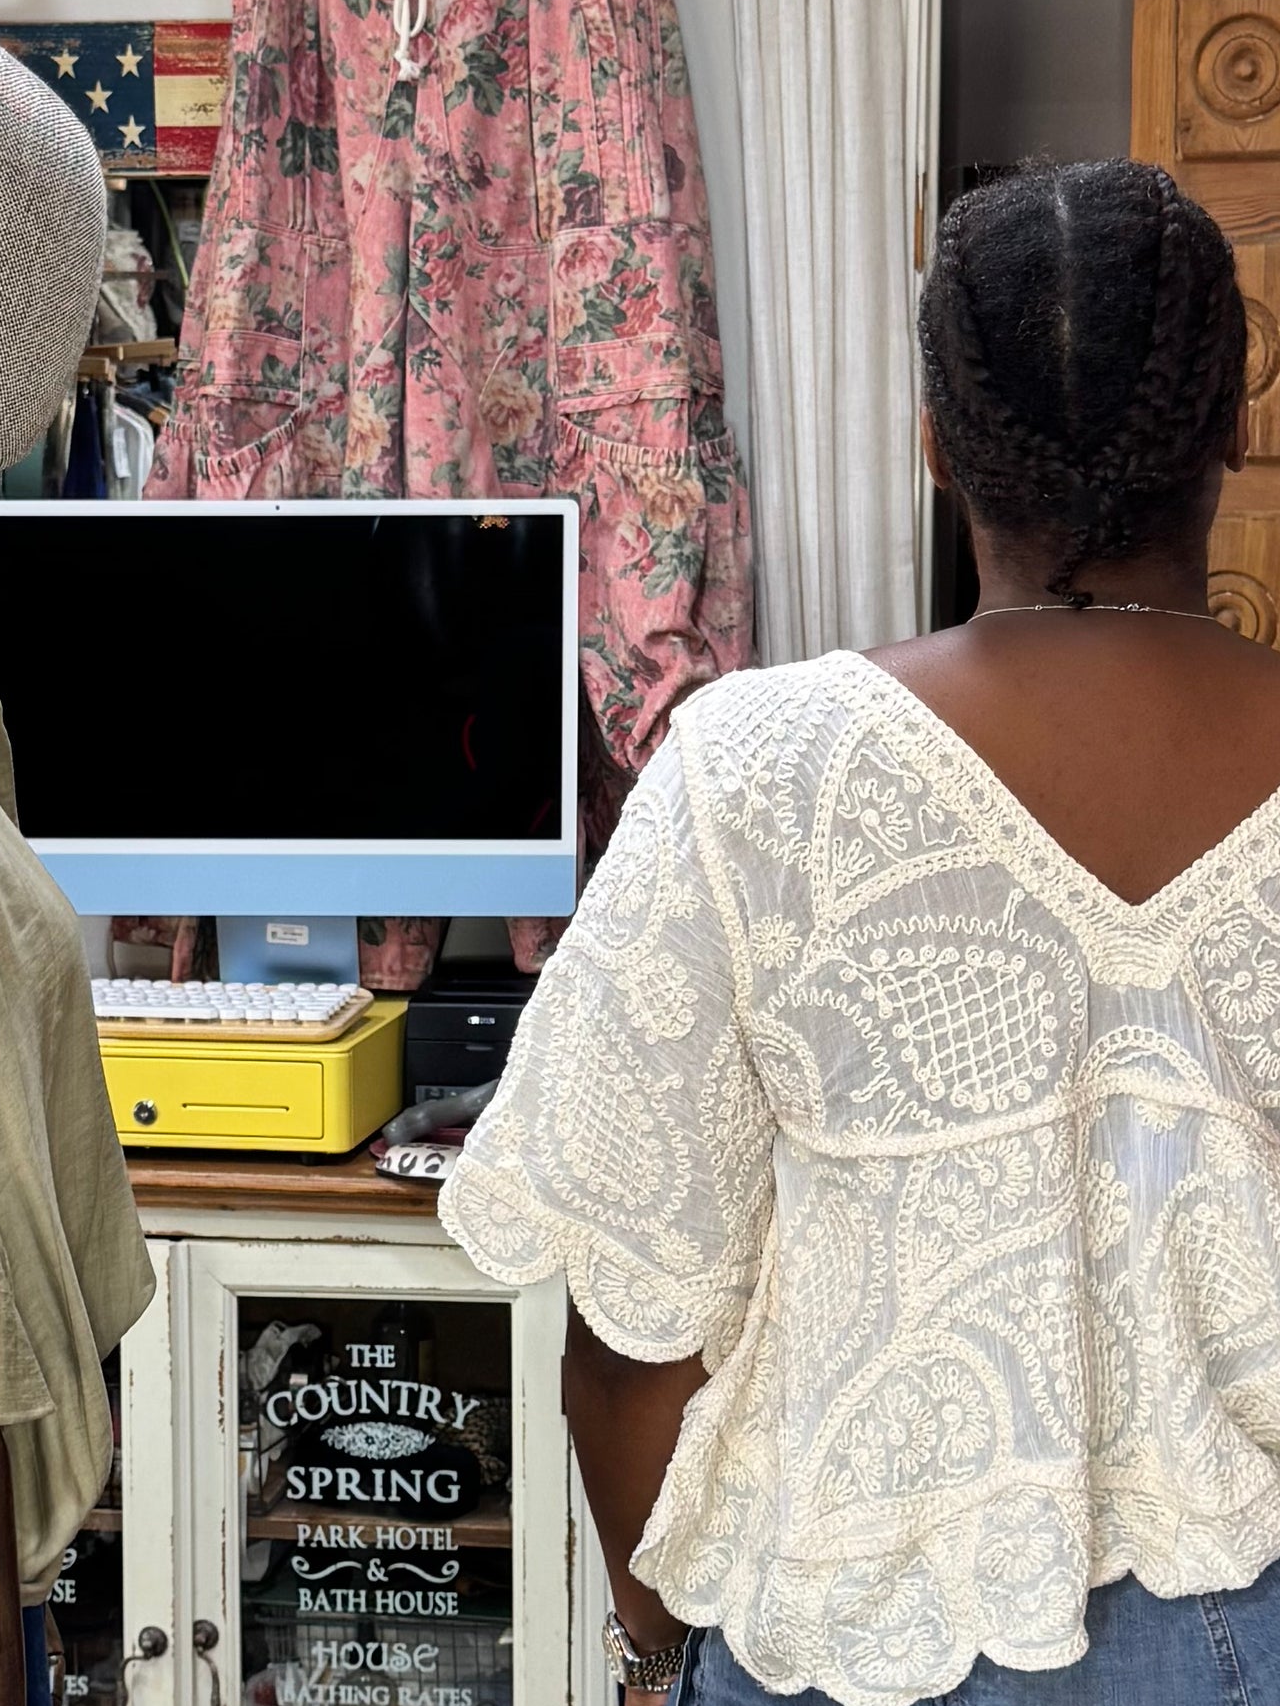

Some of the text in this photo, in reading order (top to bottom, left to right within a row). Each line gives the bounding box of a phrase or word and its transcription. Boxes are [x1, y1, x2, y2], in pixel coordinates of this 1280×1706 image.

[345, 1344, 396, 1369] THE
[266, 1379, 481, 1430] COUNTRY
[286, 1465, 461, 1503] SPRING
[296, 1524, 459, 1551] PARK HOTEL
[366, 1557, 389, 1582] &
[297, 1588, 459, 1616] BATH HOUSE
[283, 1682, 391, 1706] BATHING
